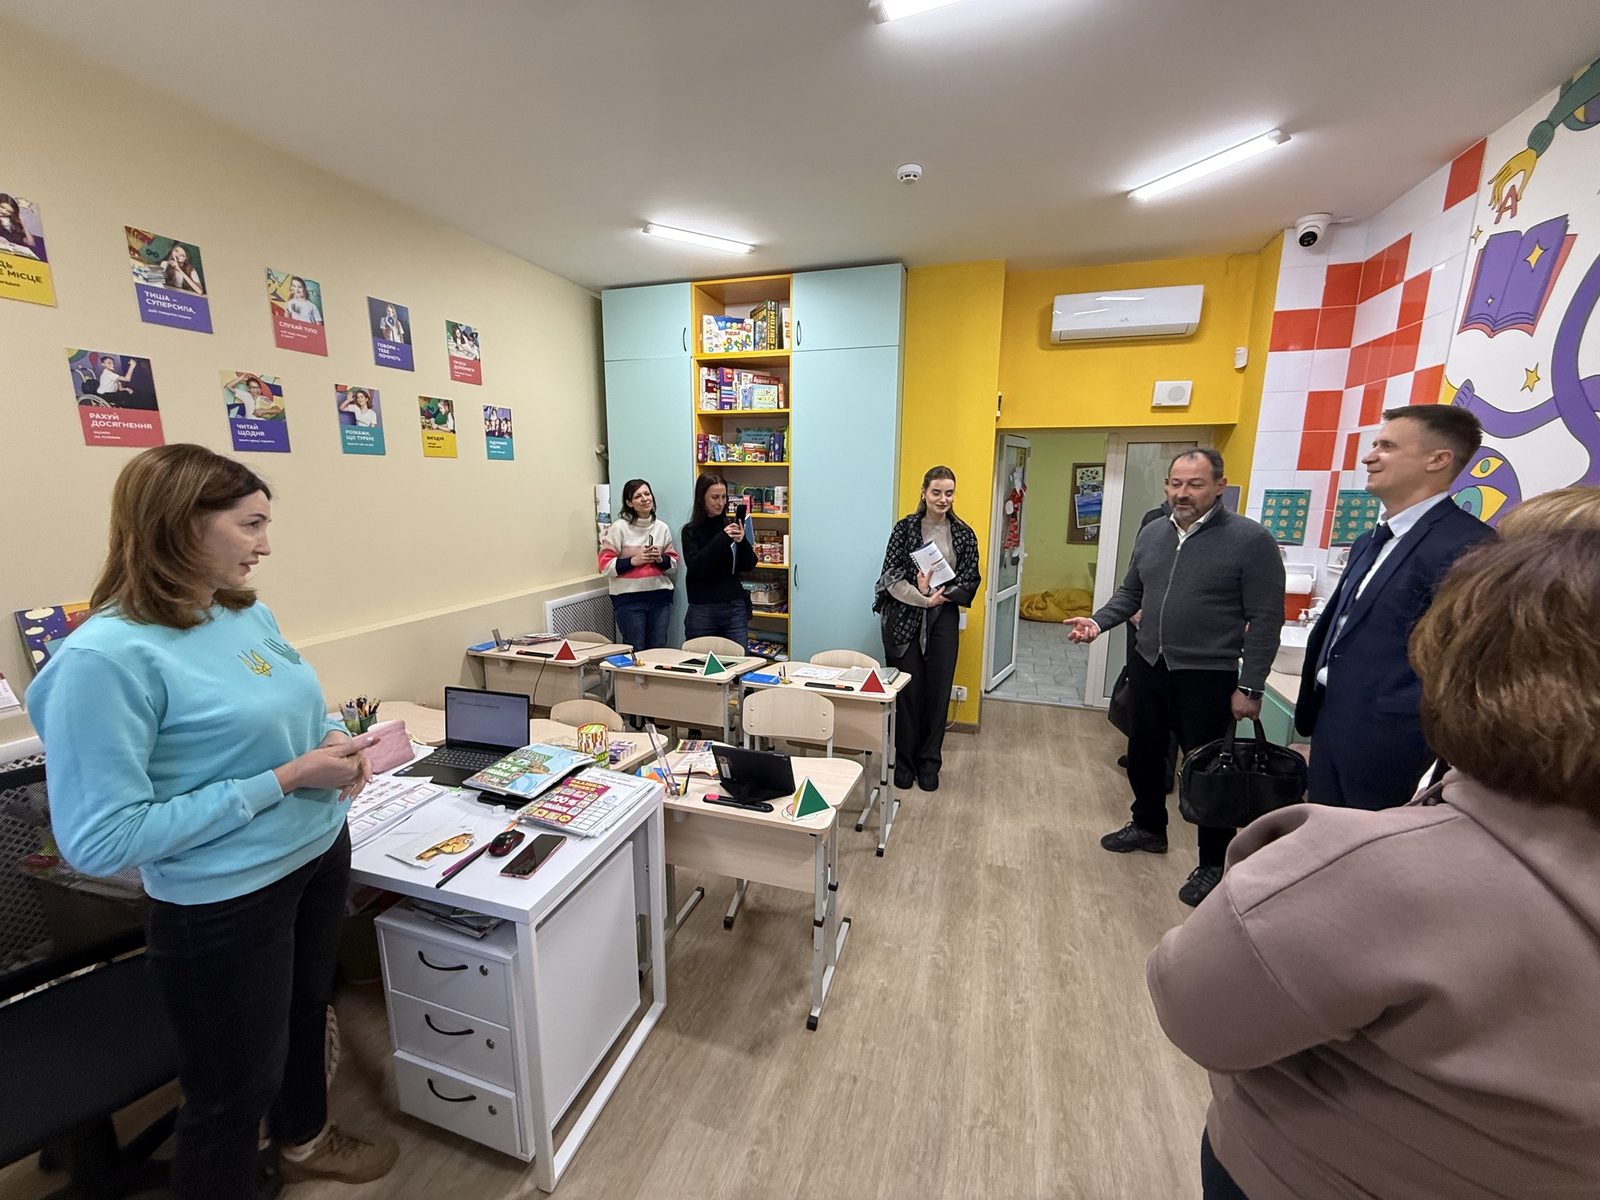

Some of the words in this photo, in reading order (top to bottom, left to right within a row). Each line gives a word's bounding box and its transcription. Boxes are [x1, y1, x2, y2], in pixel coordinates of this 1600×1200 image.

[7, 269, 42, 284] МІСЦЕ
[144, 290, 171, 302] ТИША
[279, 321, 303, 331] СЛУХАЙ
[303, 326, 318, 335] ТІЛО
[89, 412, 120, 421] РАХУЙ
[90, 420, 154, 430] ДОСЯГНЕННЯ
[236, 423, 259, 431] ЧИТАЙ
